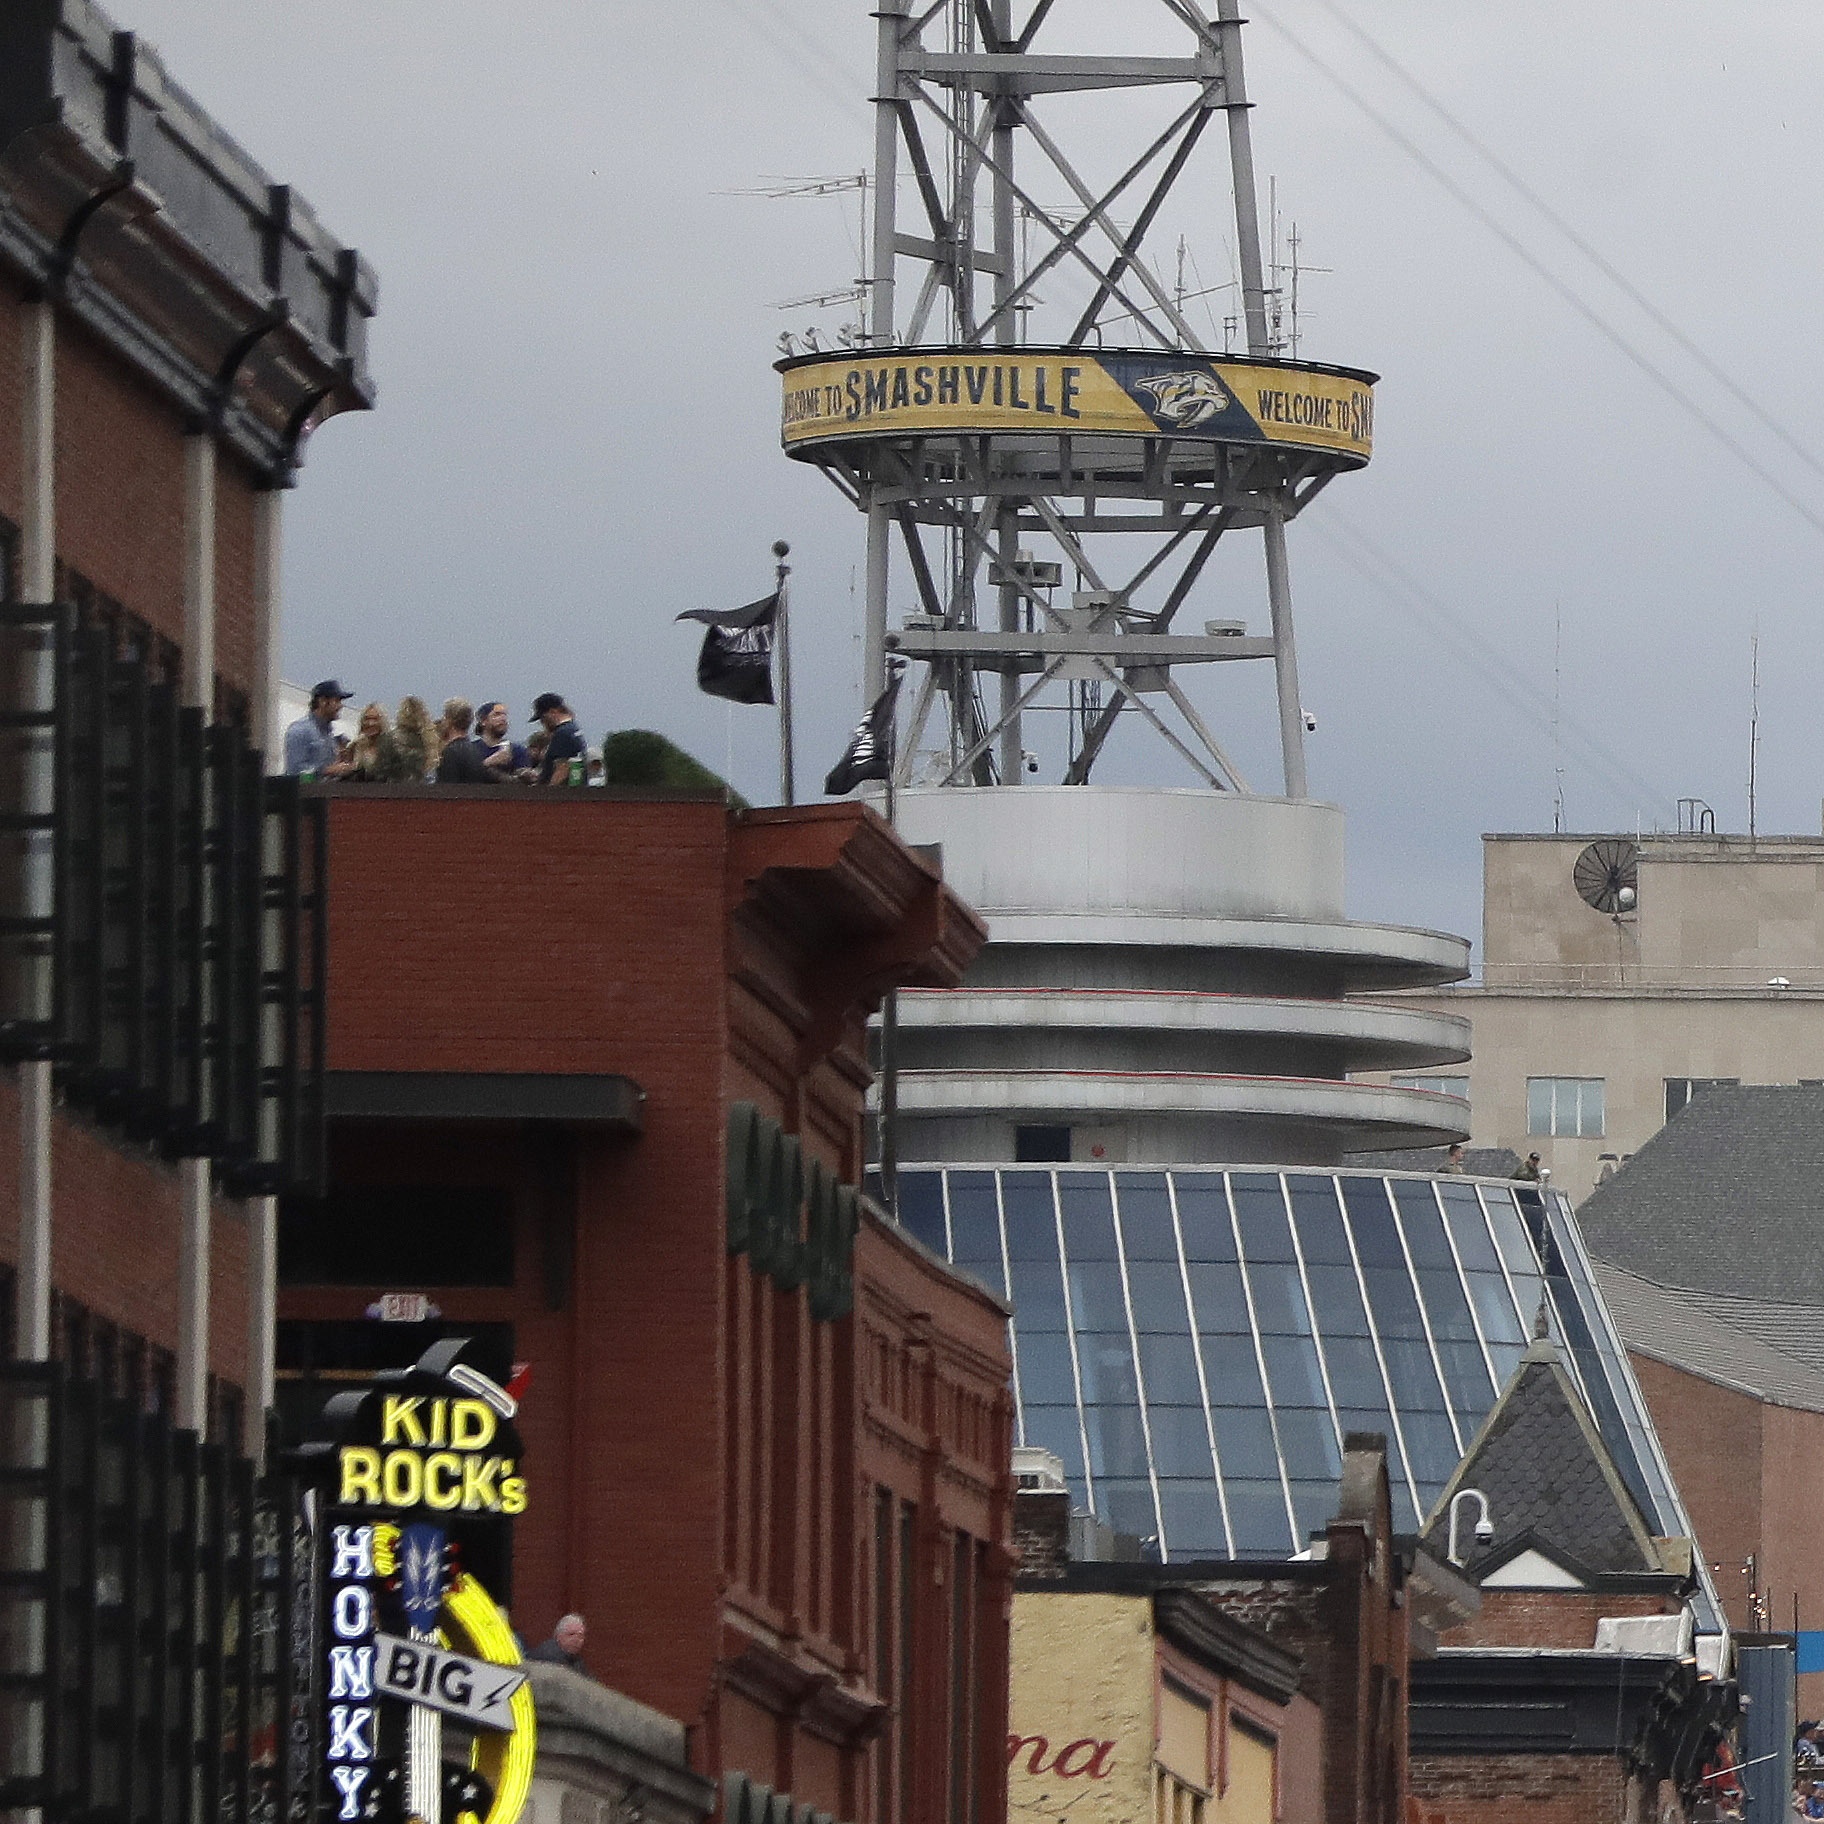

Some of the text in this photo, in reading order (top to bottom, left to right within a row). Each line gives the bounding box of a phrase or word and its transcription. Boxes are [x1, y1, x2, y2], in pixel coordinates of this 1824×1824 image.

[845, 365, 1080, 421] SMASHVILLE
[1258, 389, 1332, 429] WELCOME
[1335, 400, 1350, 431] TO
[382, 1393, 498, 1451] KID
[338, 1446, 529, 1515] ROCK's
[327, 1522, 375, 1822] HONKY
[386, 1645, 475, 1704] BIG
